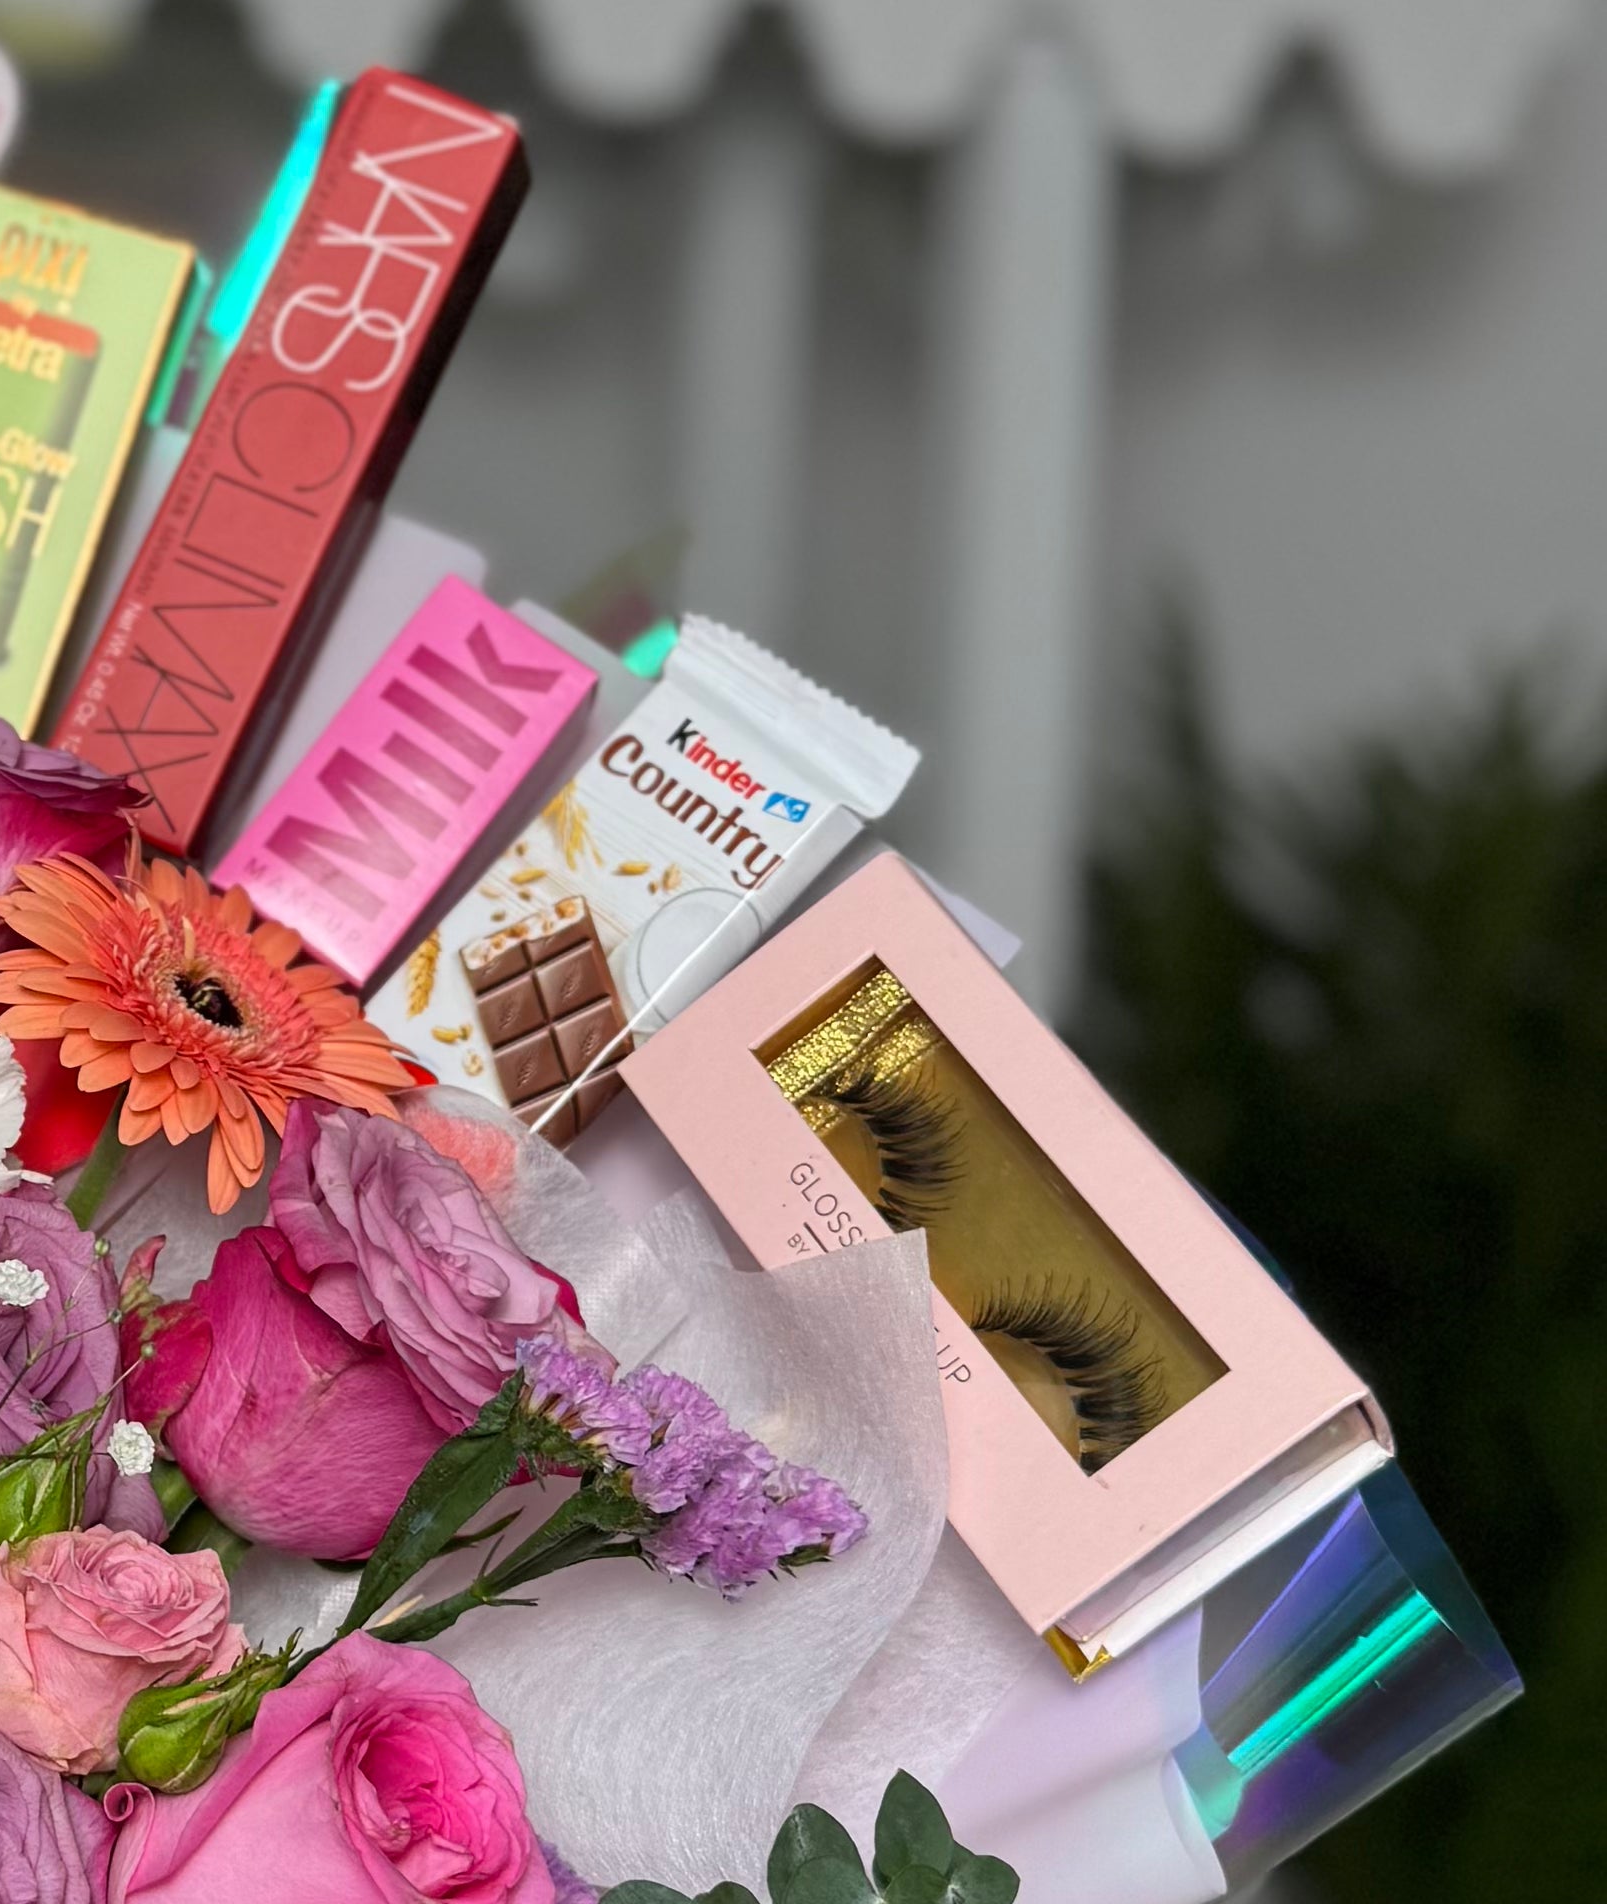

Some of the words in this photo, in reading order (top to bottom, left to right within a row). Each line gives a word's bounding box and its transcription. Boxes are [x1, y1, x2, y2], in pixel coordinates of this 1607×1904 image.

[272, 83, 502, 392] NARS
[96, 382, 356, 833] CLIMAX
[665, 717, 767, 800] Kinder
[599, 733, 784, 890] Country
[242, 856, 364, 943] MAKEUP
[787, 1232, 812, 1256] BY
[789, 1161, 869, 1248] GLOSS
